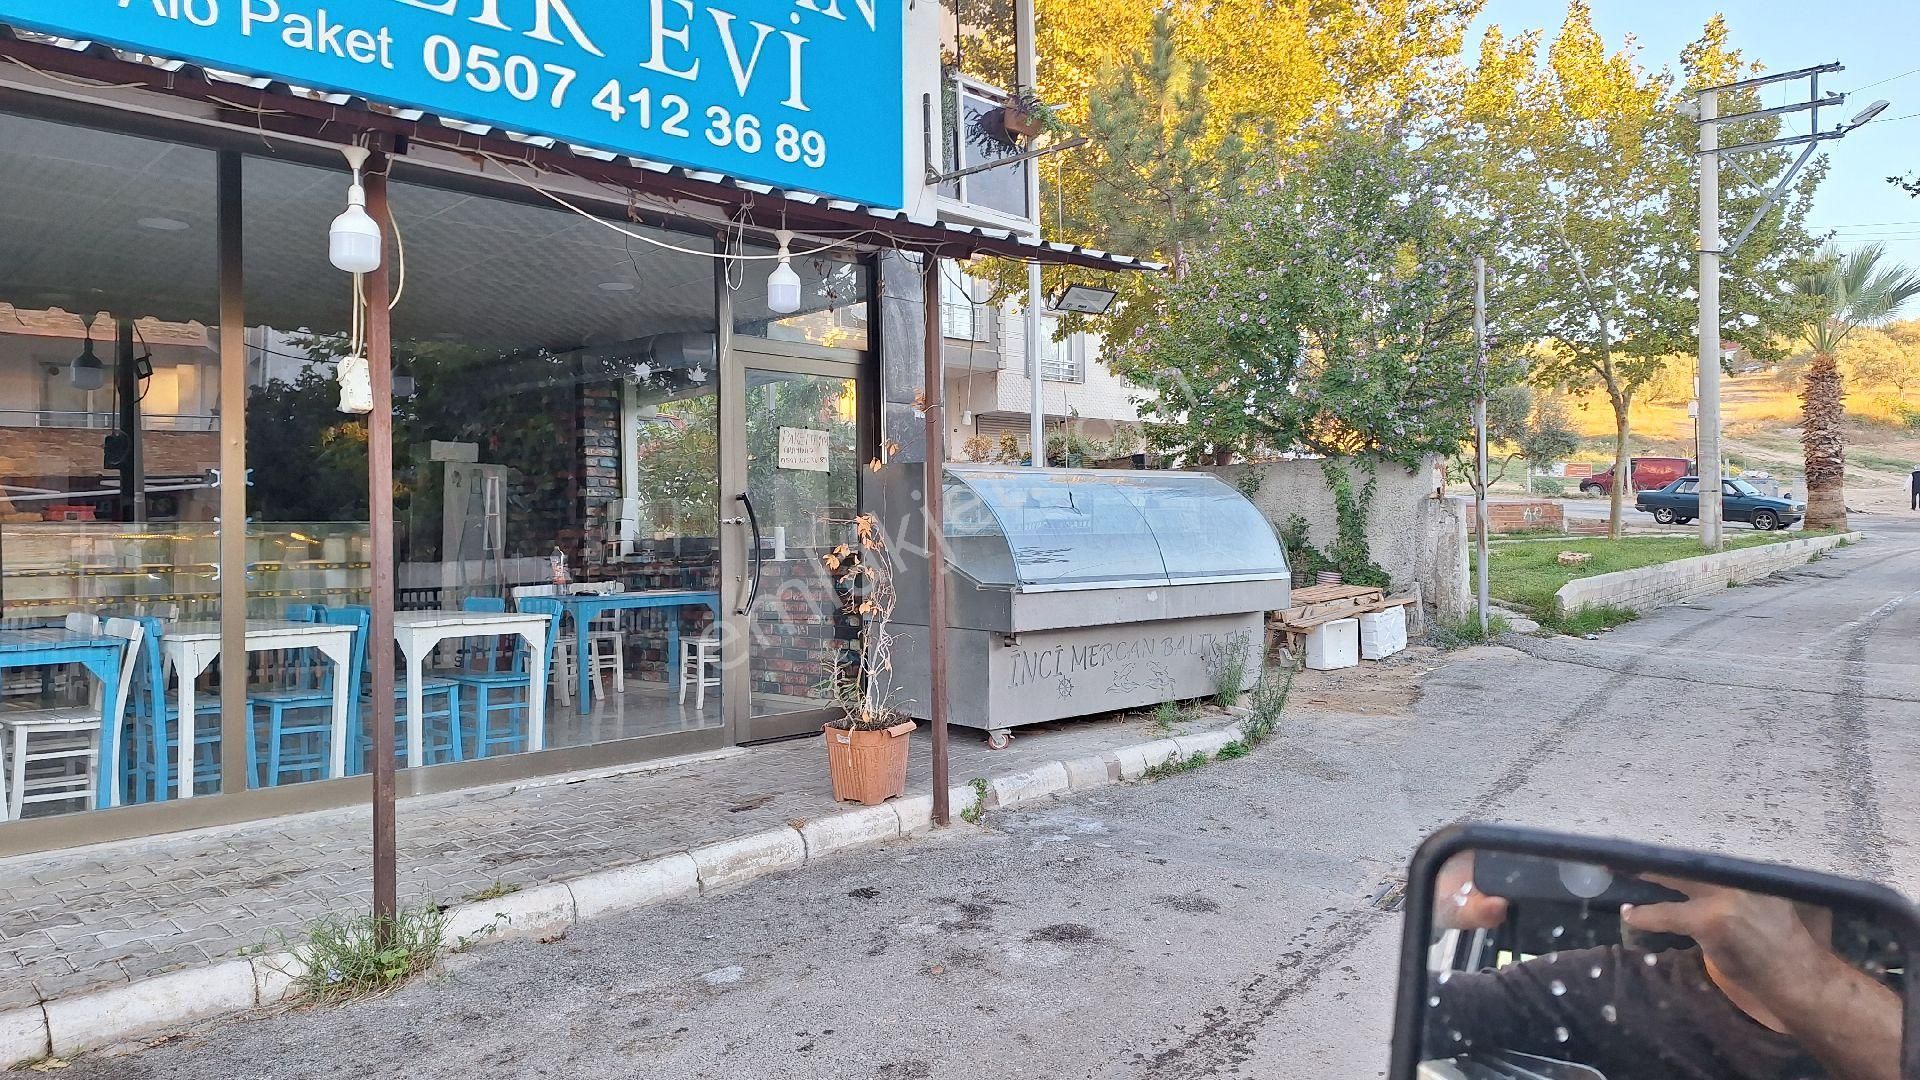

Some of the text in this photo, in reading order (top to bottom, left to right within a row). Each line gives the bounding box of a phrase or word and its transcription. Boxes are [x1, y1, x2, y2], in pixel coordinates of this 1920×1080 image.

[241, 0, 394, 70] Paket
[639, 0, 811, 112] EVİ
[422, 34, 827, 169] 0507 412 36 89
[1071, 637, 1156, 673] MERCAN
